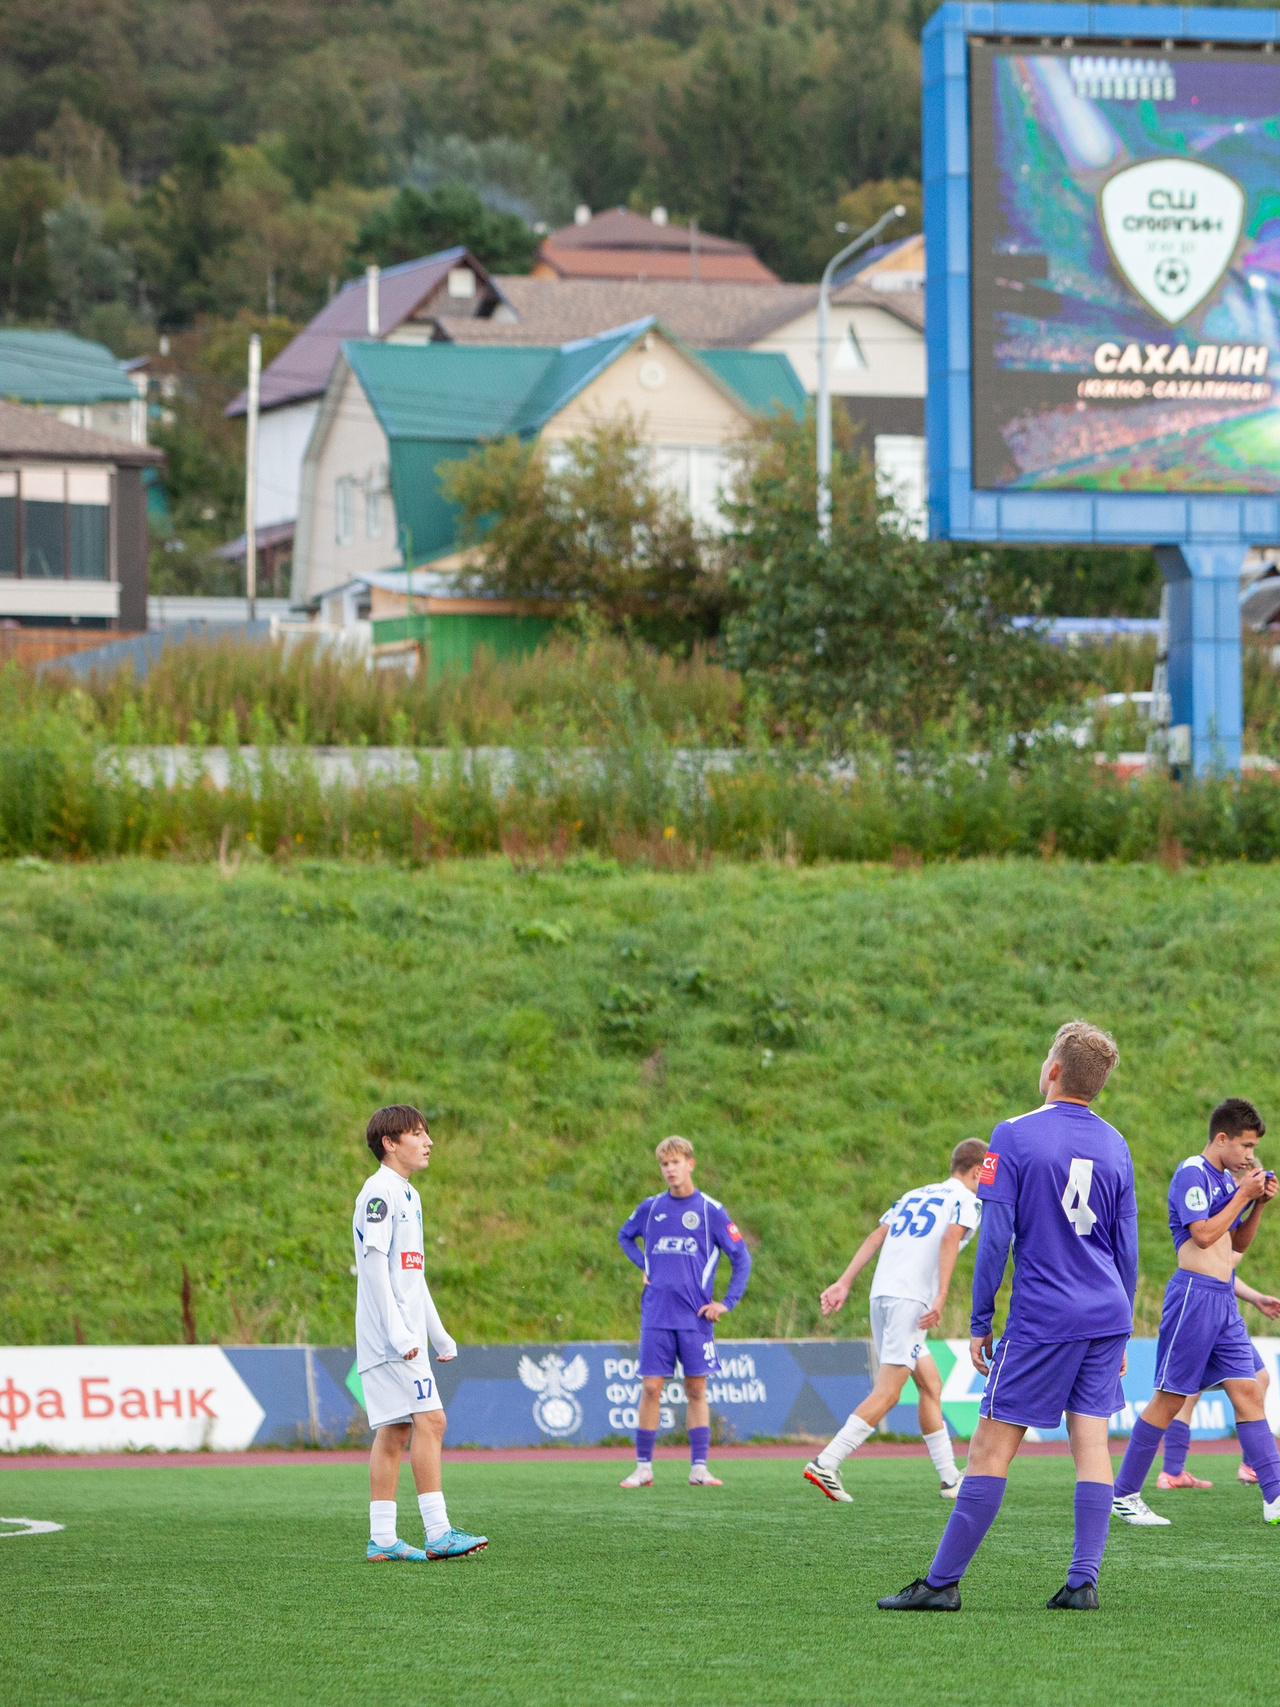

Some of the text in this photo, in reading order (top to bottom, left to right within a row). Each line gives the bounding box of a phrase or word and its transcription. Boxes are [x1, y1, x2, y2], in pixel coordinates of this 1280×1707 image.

[1094, 342, 1269, 376] САХАЛИН
[1061, 1157, 1097, 1235] 4
[890, 1197, 944, 1237] 55
[80, 1377, 219, 1420] Банк
[413, 1377, 432, 1400] 17
